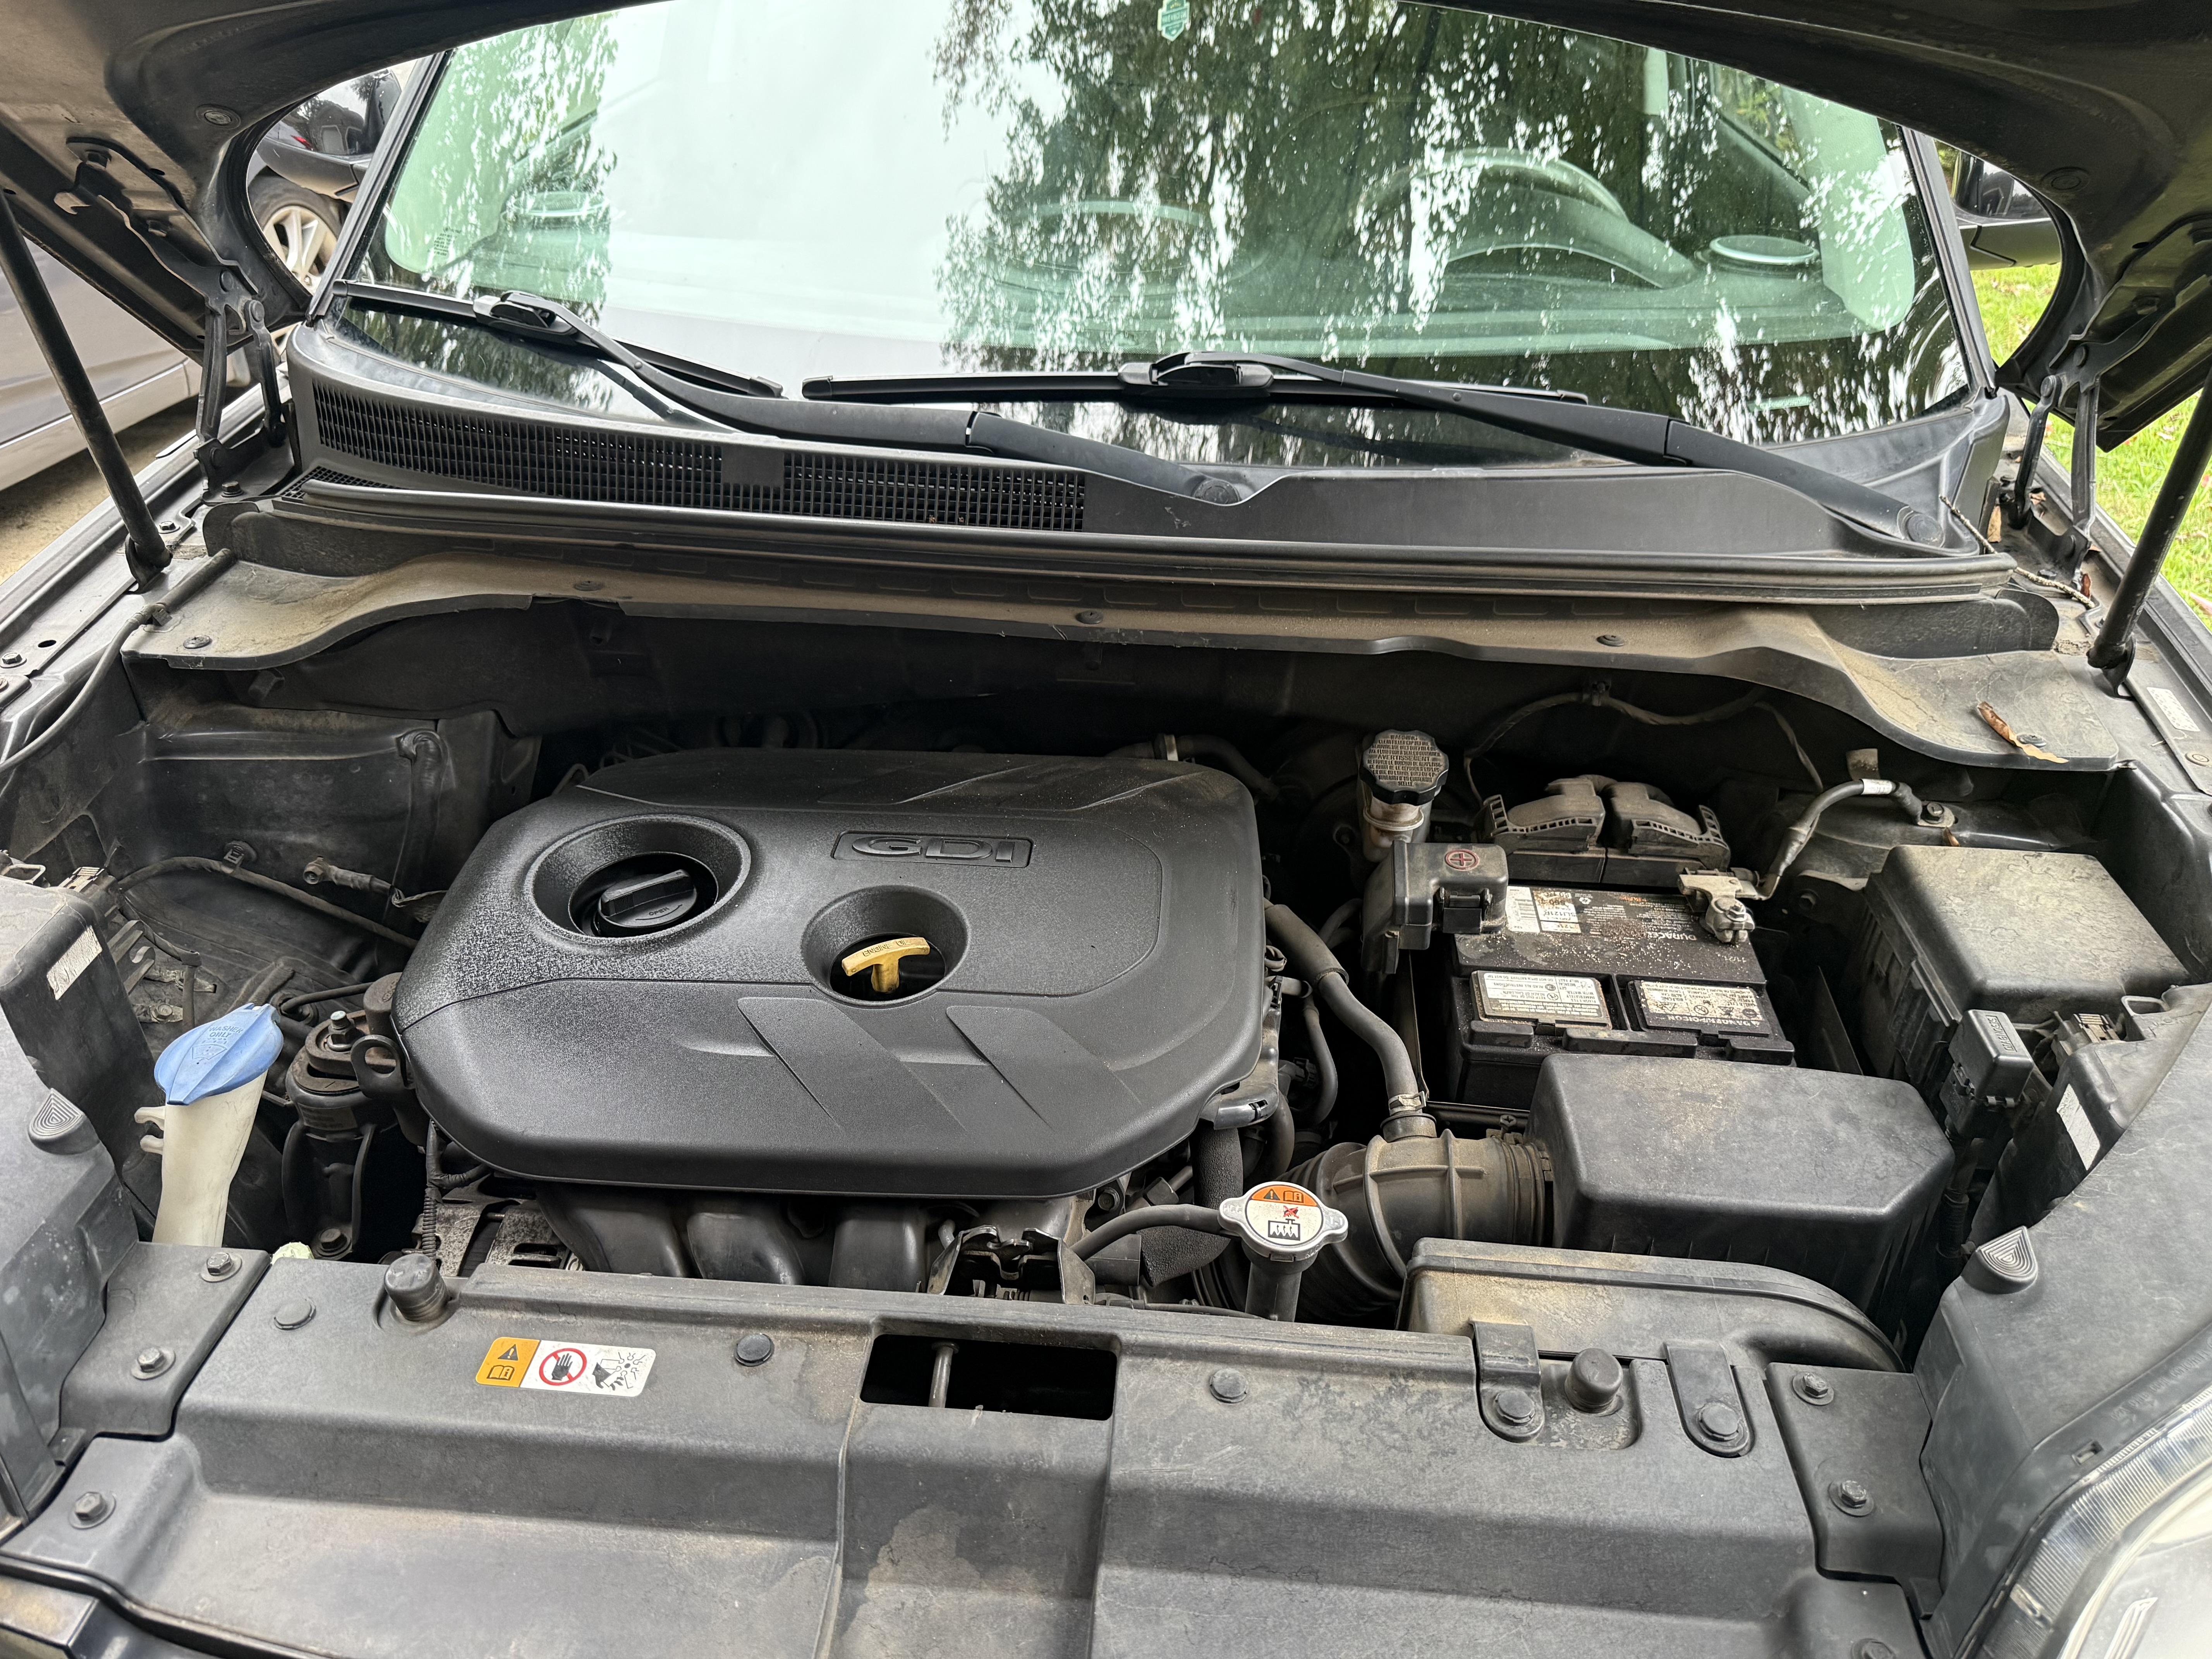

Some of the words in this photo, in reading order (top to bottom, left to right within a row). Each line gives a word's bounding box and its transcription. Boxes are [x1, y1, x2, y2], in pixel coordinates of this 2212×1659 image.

[852, 836, 1015, 863] GDI
[649, 907, 670, 916] OPEN
[862, 943, 892, 957] ENGINE
[1987, 1017, 2014, 1052] DIAGNOSIS
